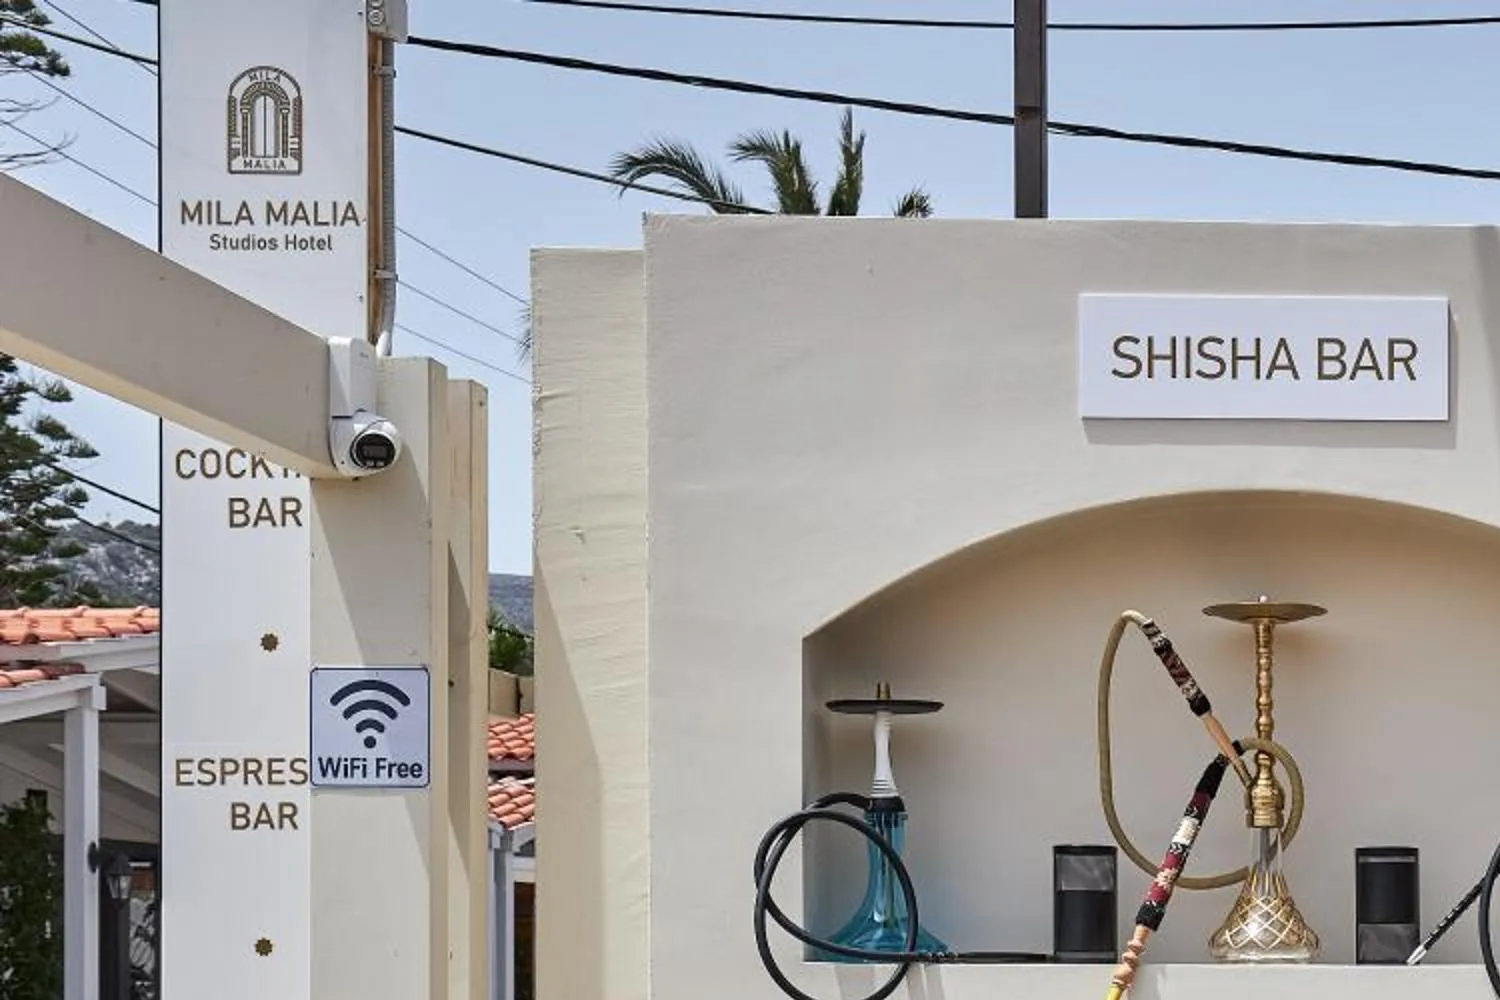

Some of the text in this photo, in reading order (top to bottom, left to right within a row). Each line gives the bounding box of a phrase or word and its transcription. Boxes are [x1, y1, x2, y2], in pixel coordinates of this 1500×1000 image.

[248, 70, 282, 82] MILA
[243, 159, 287, 169] MALIA
[180, 200, 361, 227] MILA MALIA
[209, 233, 333, 251] Studios Hotel
[1111, 335, 1419, 381] SHISHA BAR
[175, 447, 301, 480] COCK
[228, 496, 303, 529] BAR
[175, 757, 309, 787] ESPRES
[317, 756, 423, 779] WiFi Free
[230, 802, 300, 831] BAR
